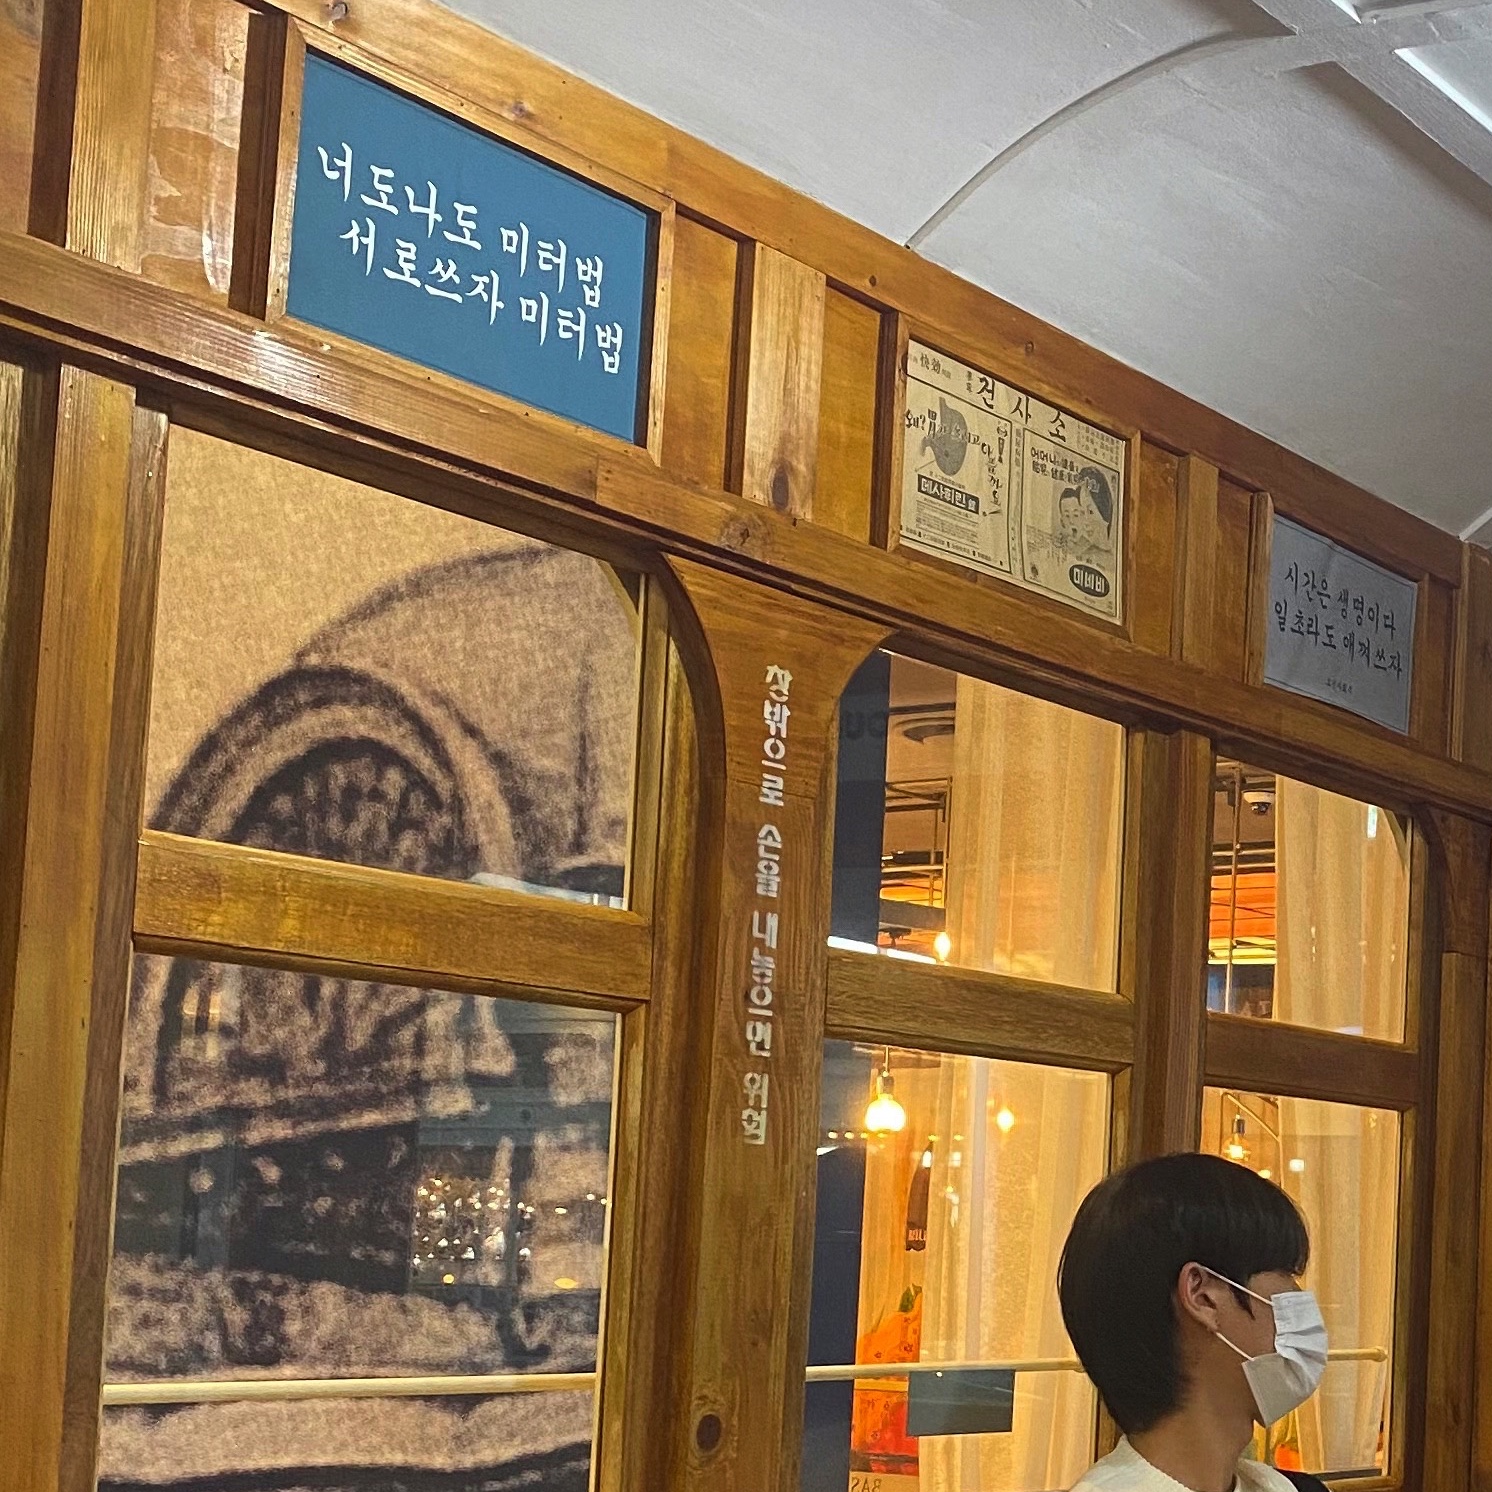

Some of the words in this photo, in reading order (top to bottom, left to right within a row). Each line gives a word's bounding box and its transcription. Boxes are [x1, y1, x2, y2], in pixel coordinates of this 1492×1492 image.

[317, 142, 482, 251] 너도나도
[499, 221, 604, 308] 미터법
[340, 217, 505, 326] 서로쓰자
[519, 291, 624, 374] 미터법
[1285, 561, 1331, 609] 시간은
[1337, 588, 1396, 641] 생명이다
[758, 664, 793, 807] 창밖으로
[756, 824, 782, 898] 손을
[746, 910, 779, 1058] 내놓으면
[741, 1072, 769, 1145] 위험
